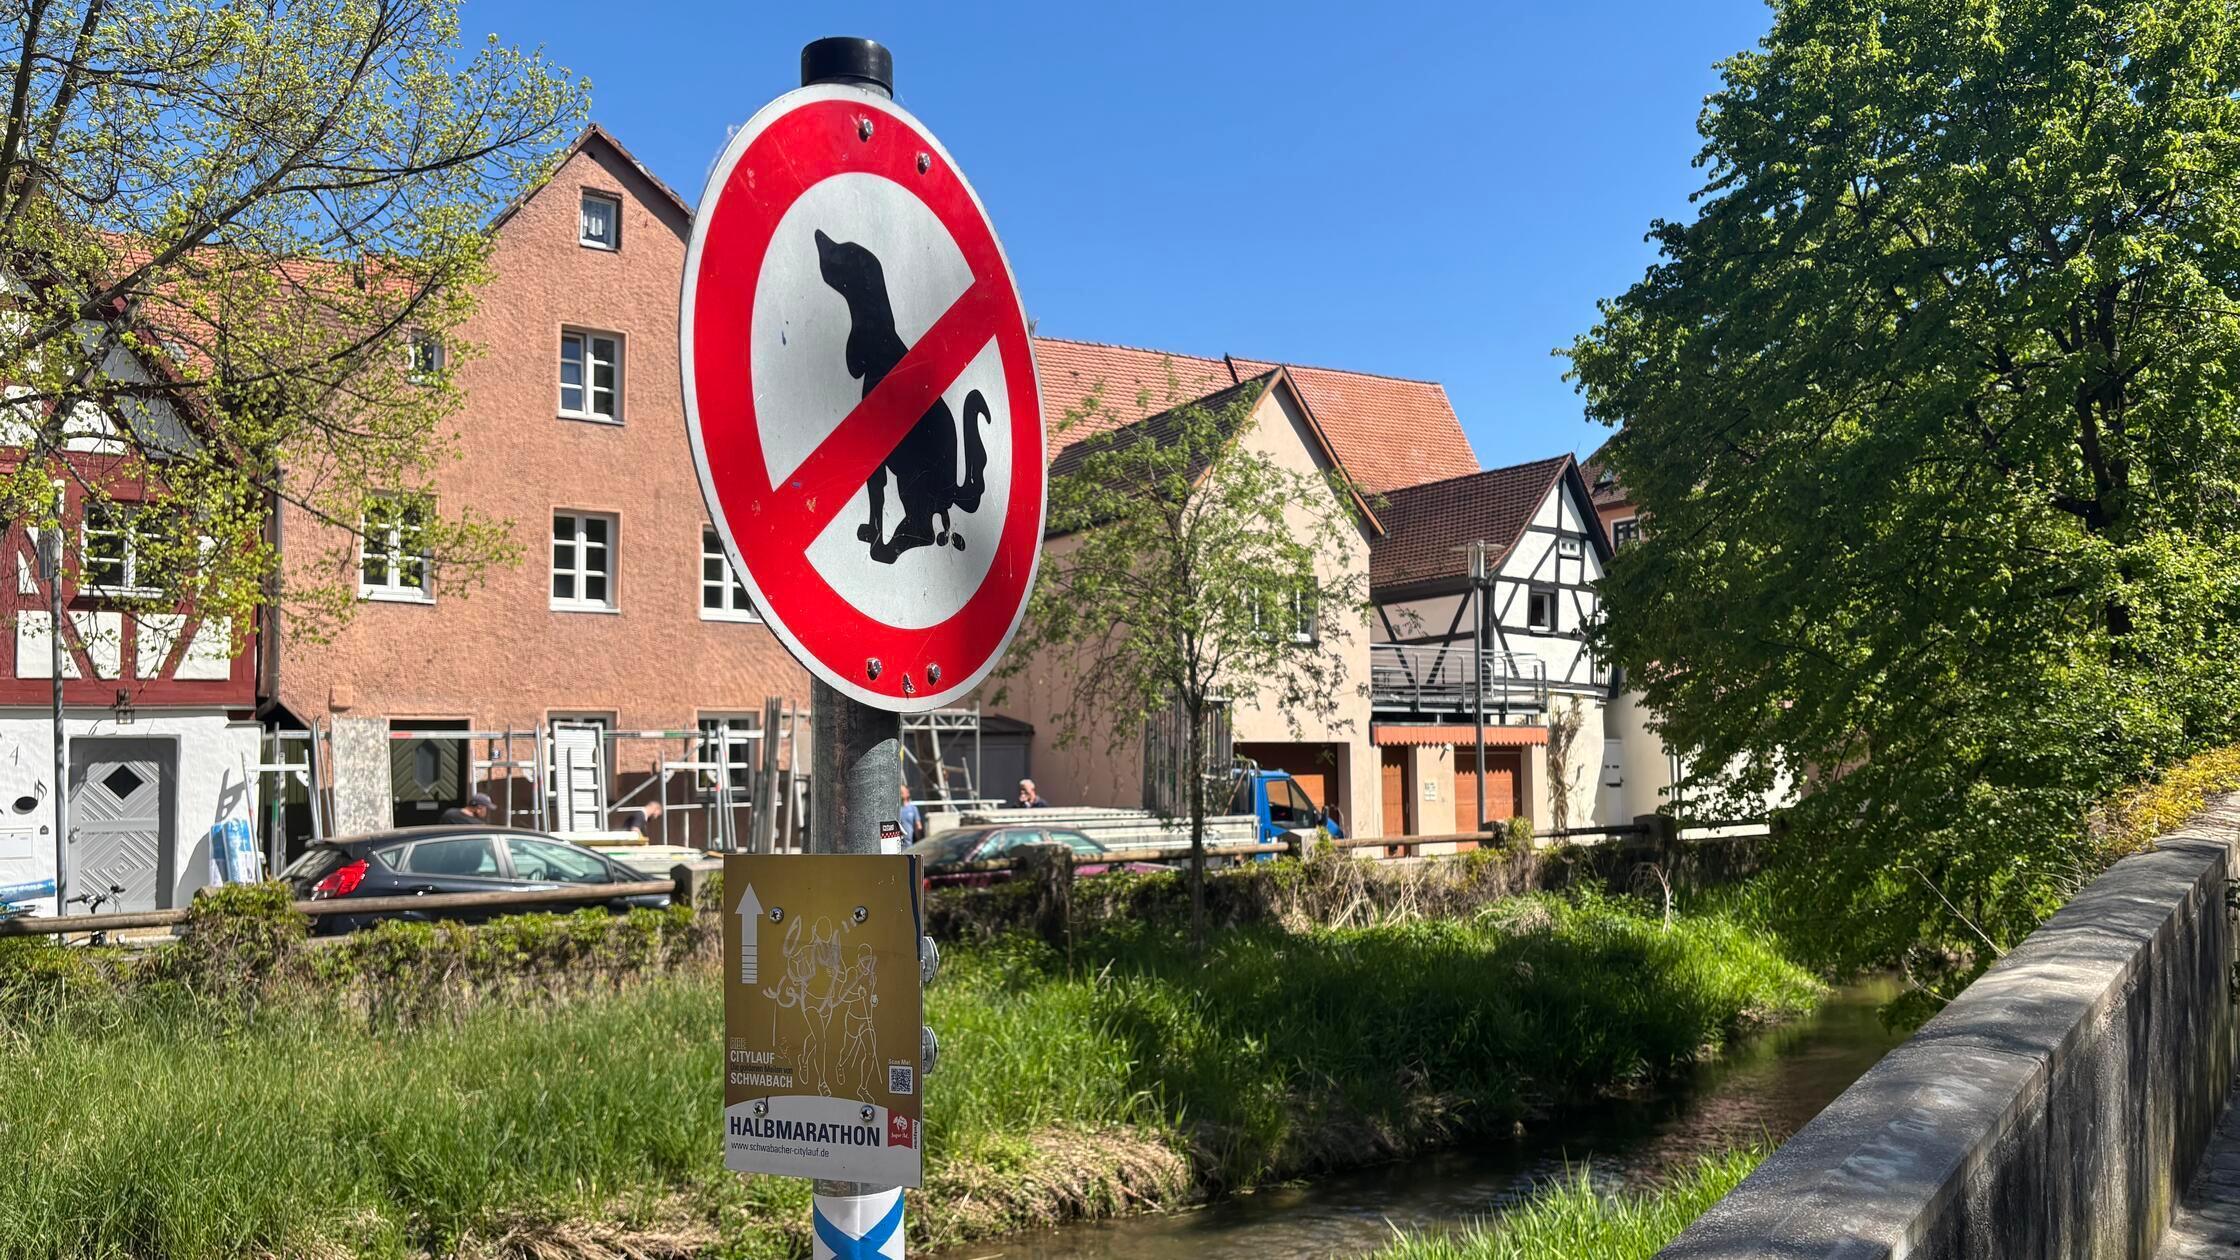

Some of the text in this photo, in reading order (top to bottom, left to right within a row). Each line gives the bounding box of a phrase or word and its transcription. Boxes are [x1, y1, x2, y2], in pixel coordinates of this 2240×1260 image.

[730, 1050, 775, 1064] CITYLAUF
[730, 1072, 793, 1088] SCHWABACH
[730, 1116, 880, 1147] HALBMARATHON
[731, 1141, 830, 1158] www.schwabacher-citylauf.de
